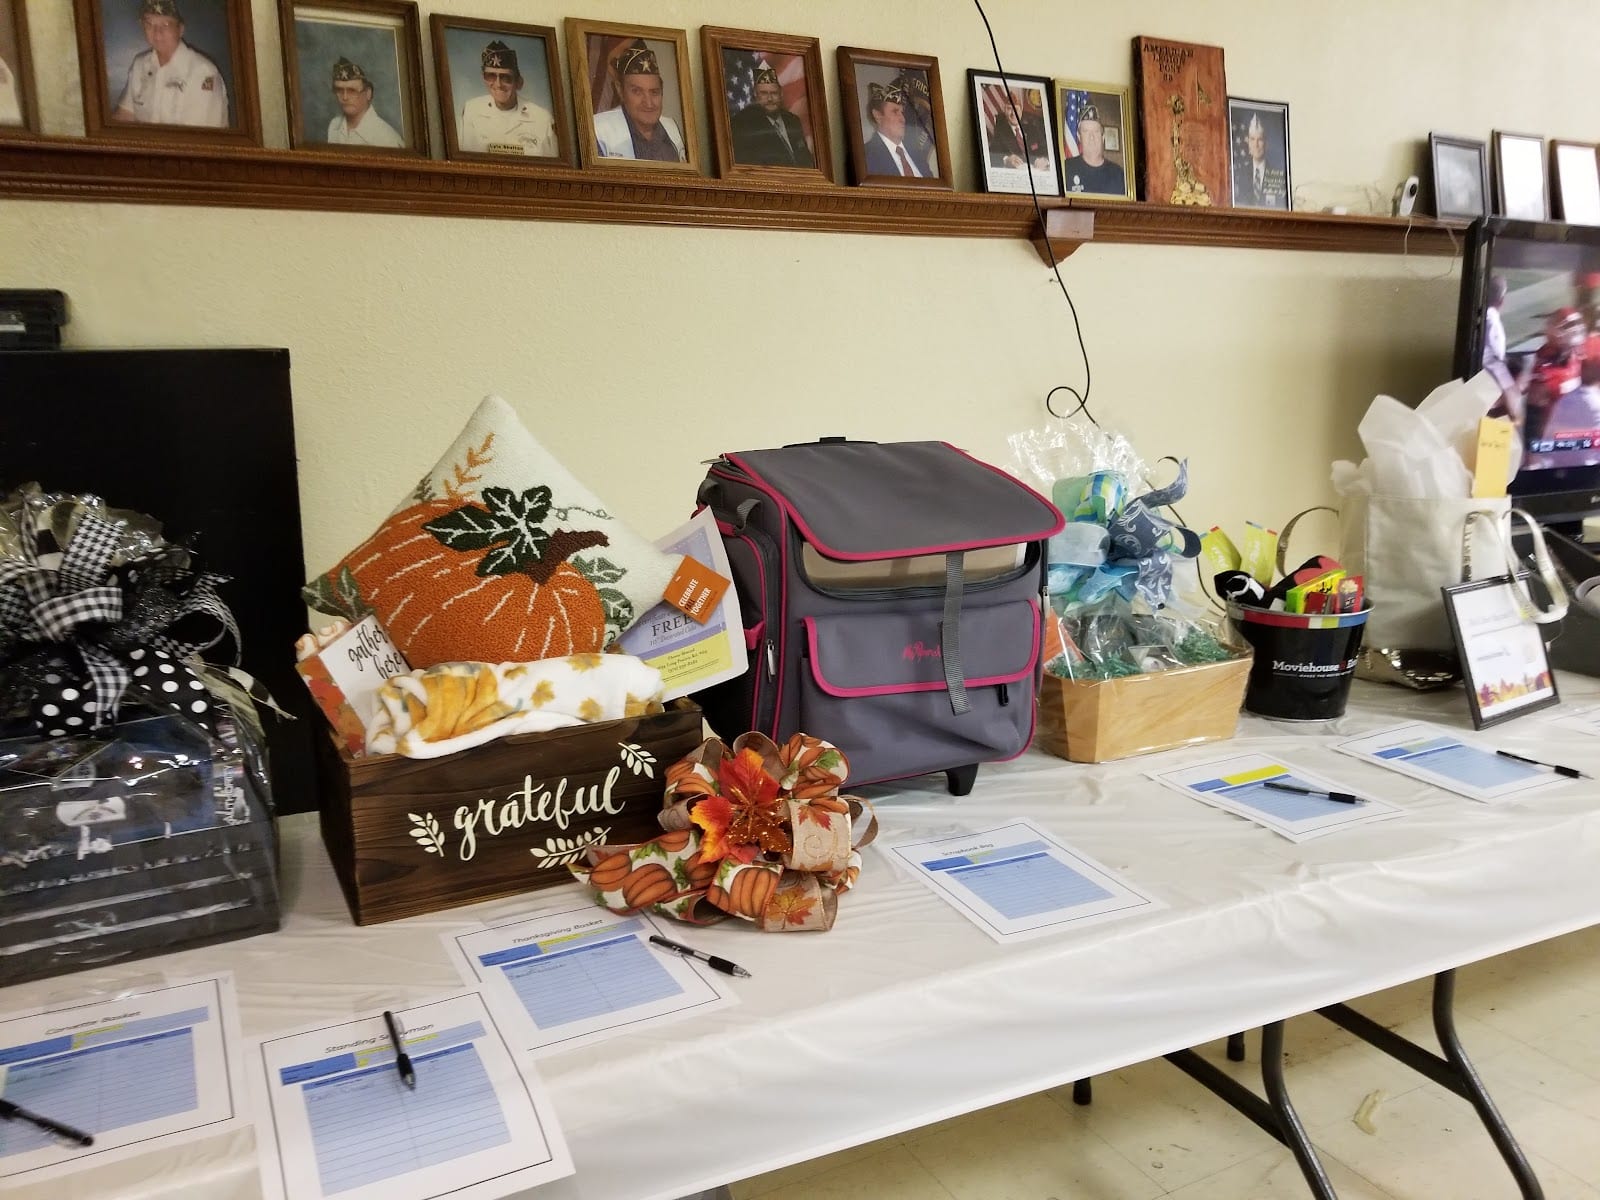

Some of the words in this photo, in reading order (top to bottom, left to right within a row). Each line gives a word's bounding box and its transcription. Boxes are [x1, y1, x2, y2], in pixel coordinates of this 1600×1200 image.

[678, 578, 699, 607] CELEBRATE
[690, 587, 712, 616] TOGETHER
[348, 623, 389, 672] gather
[373, 652, 402, 680] here
[1272, 660, 1340, 673] Moviehouse
[453, 765, 626, 861] grateful
[512, 926, 572, 944] Thanksgiving
[574, 919, 604, 931] Basket
[324, 1035, 376, 1054] Standing
